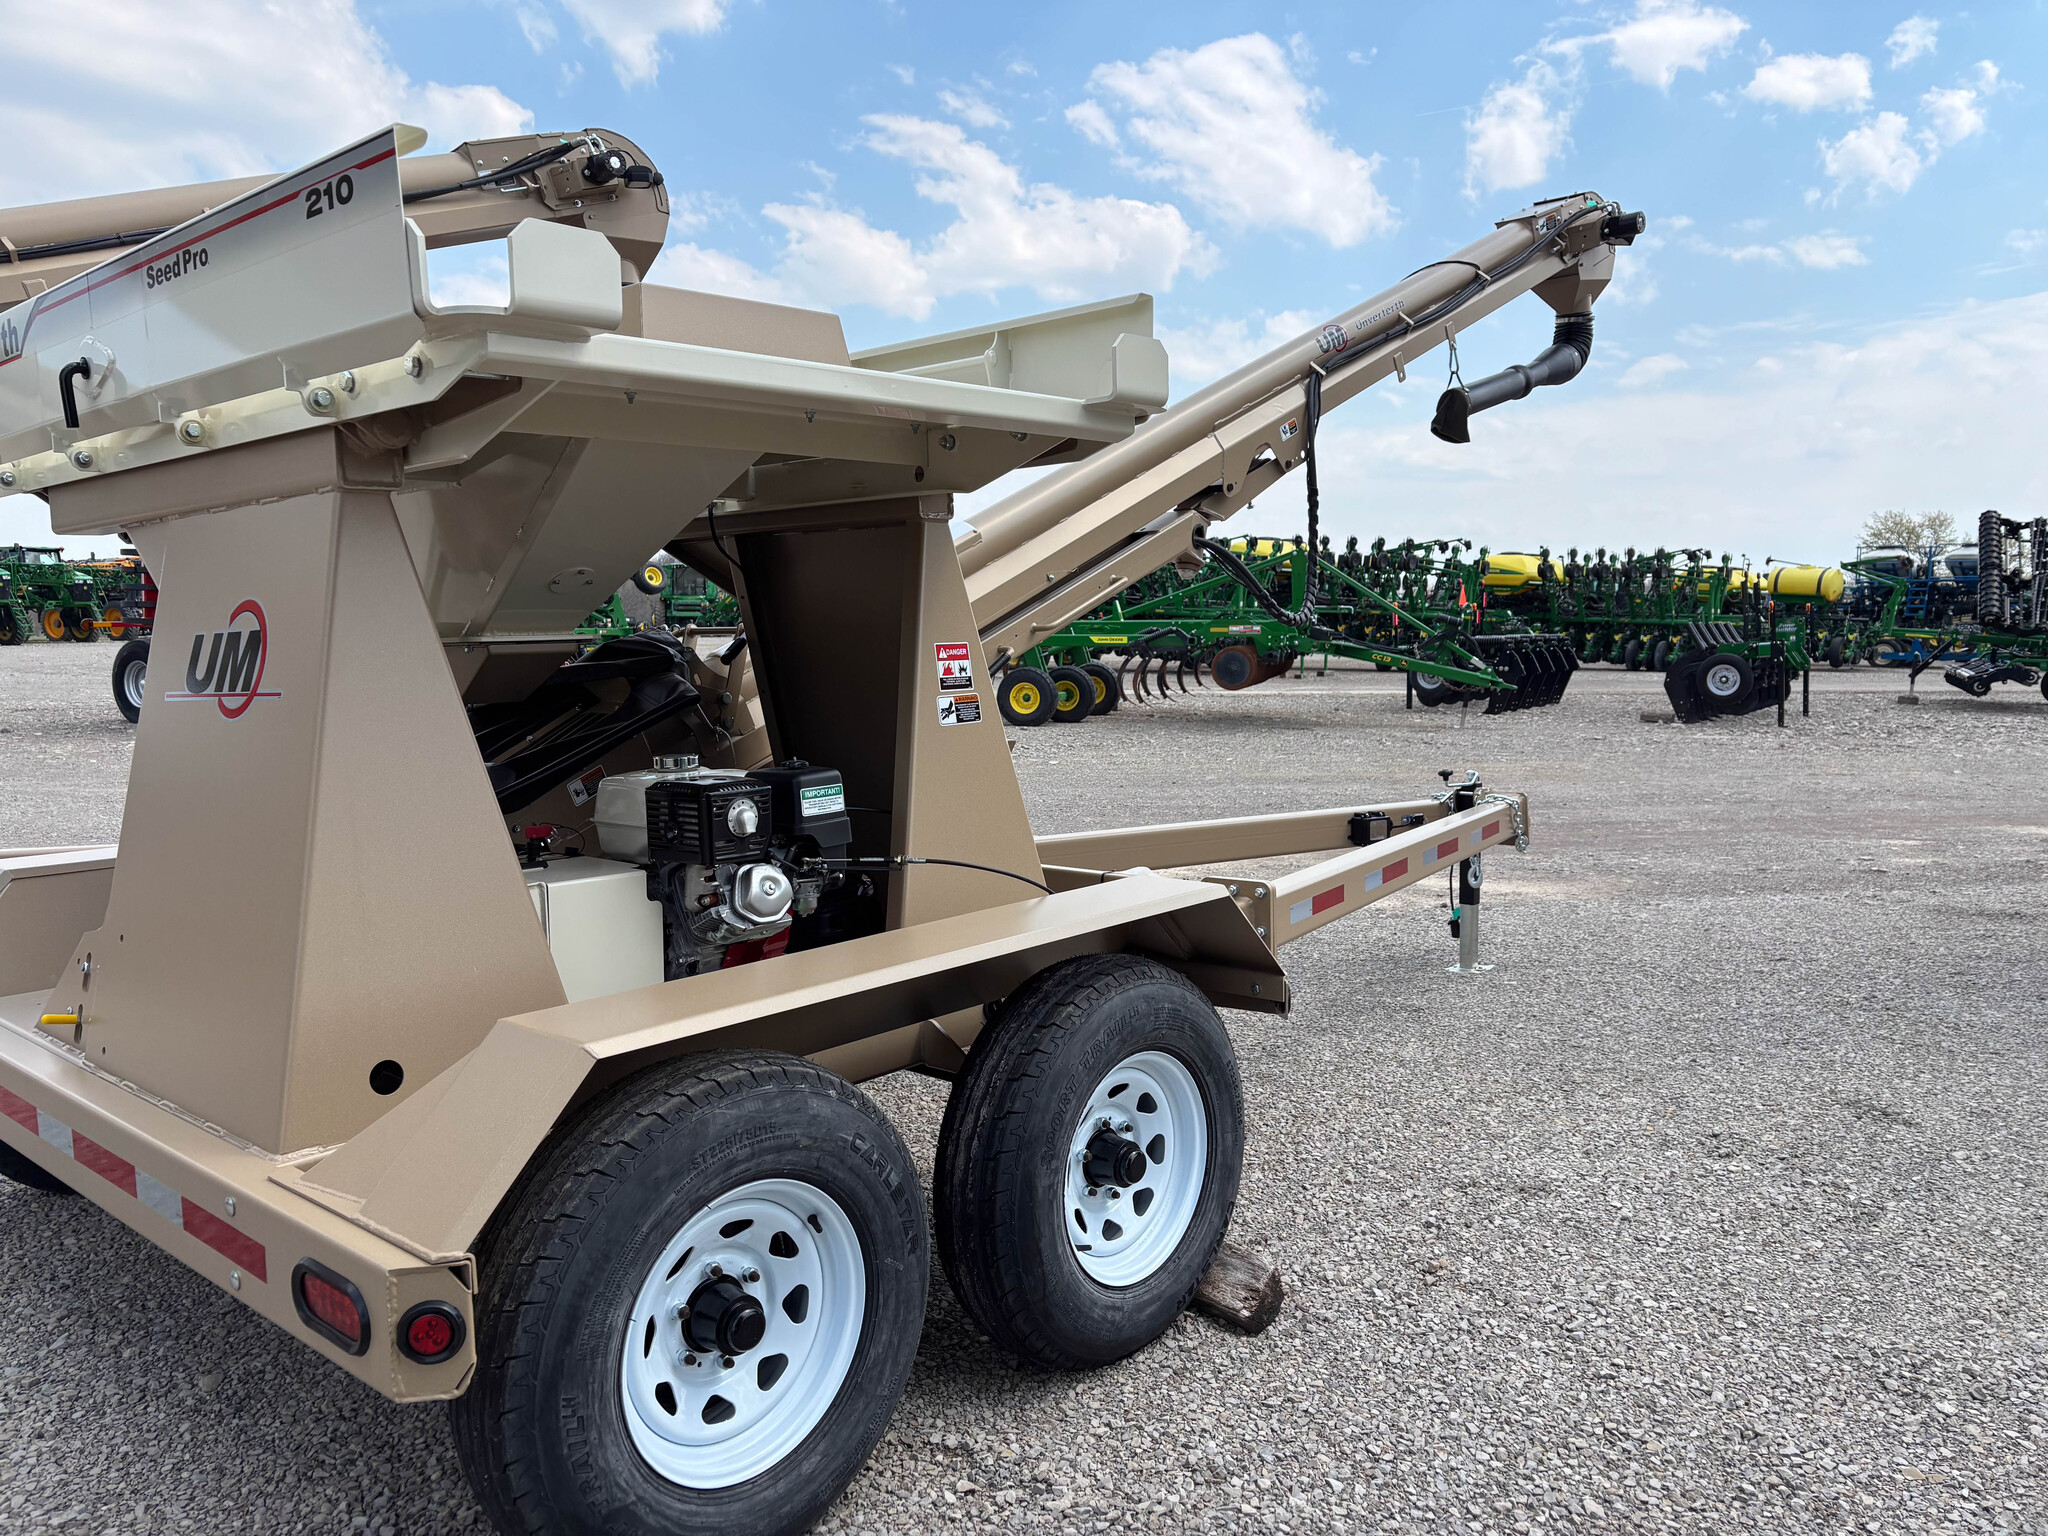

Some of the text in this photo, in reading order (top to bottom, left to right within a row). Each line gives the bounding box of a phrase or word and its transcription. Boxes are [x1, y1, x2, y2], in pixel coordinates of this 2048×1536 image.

[305, 174, 354, 220] 210
[1314, 327, 1346, 354] UM
[185, 629, 262, 694] UM
[945, 648, 967, 656] DANGER
[804, 787, 840, 799] IMPORTANT!
[1041, 1073, 1078, 1171] SPORT
[1079, 1017, 1132, 1071] TRAIL
